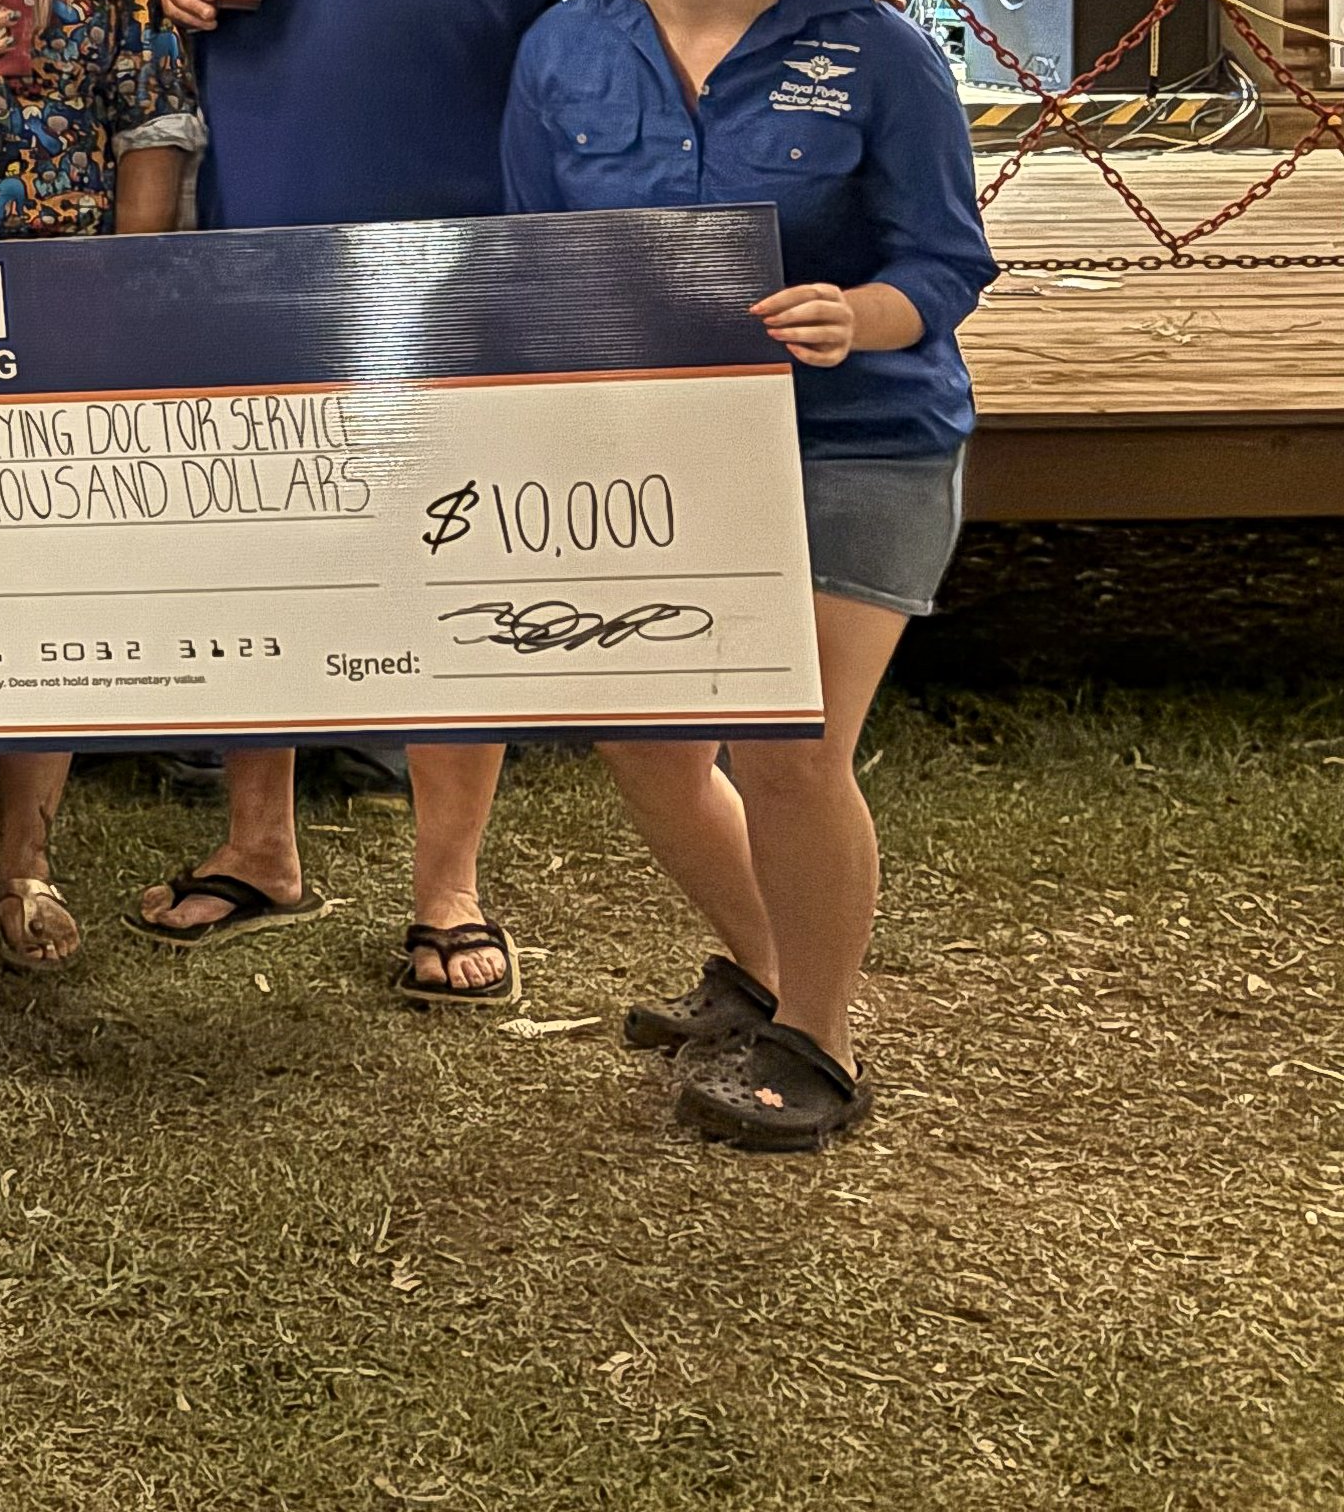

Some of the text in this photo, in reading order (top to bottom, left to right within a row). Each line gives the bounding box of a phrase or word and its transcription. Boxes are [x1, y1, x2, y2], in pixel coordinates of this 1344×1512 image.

[86, 397, 221, 456] DOCTOR
[230, 395, 358, 451] SERVICE
[181, 454, 372, 520] DOLLARS
[40, 640, 141, 662] 5032
[179, 637, 282, 659] 3123
[8, 677, 38, 688] Does
[40, 676, 61, 687] not
[63, 675, 89, 687] hold
[92, 675, 113, 689] any
[115, 674, 171, 687] monetary
[326, 651, 422, 682] Signed:
